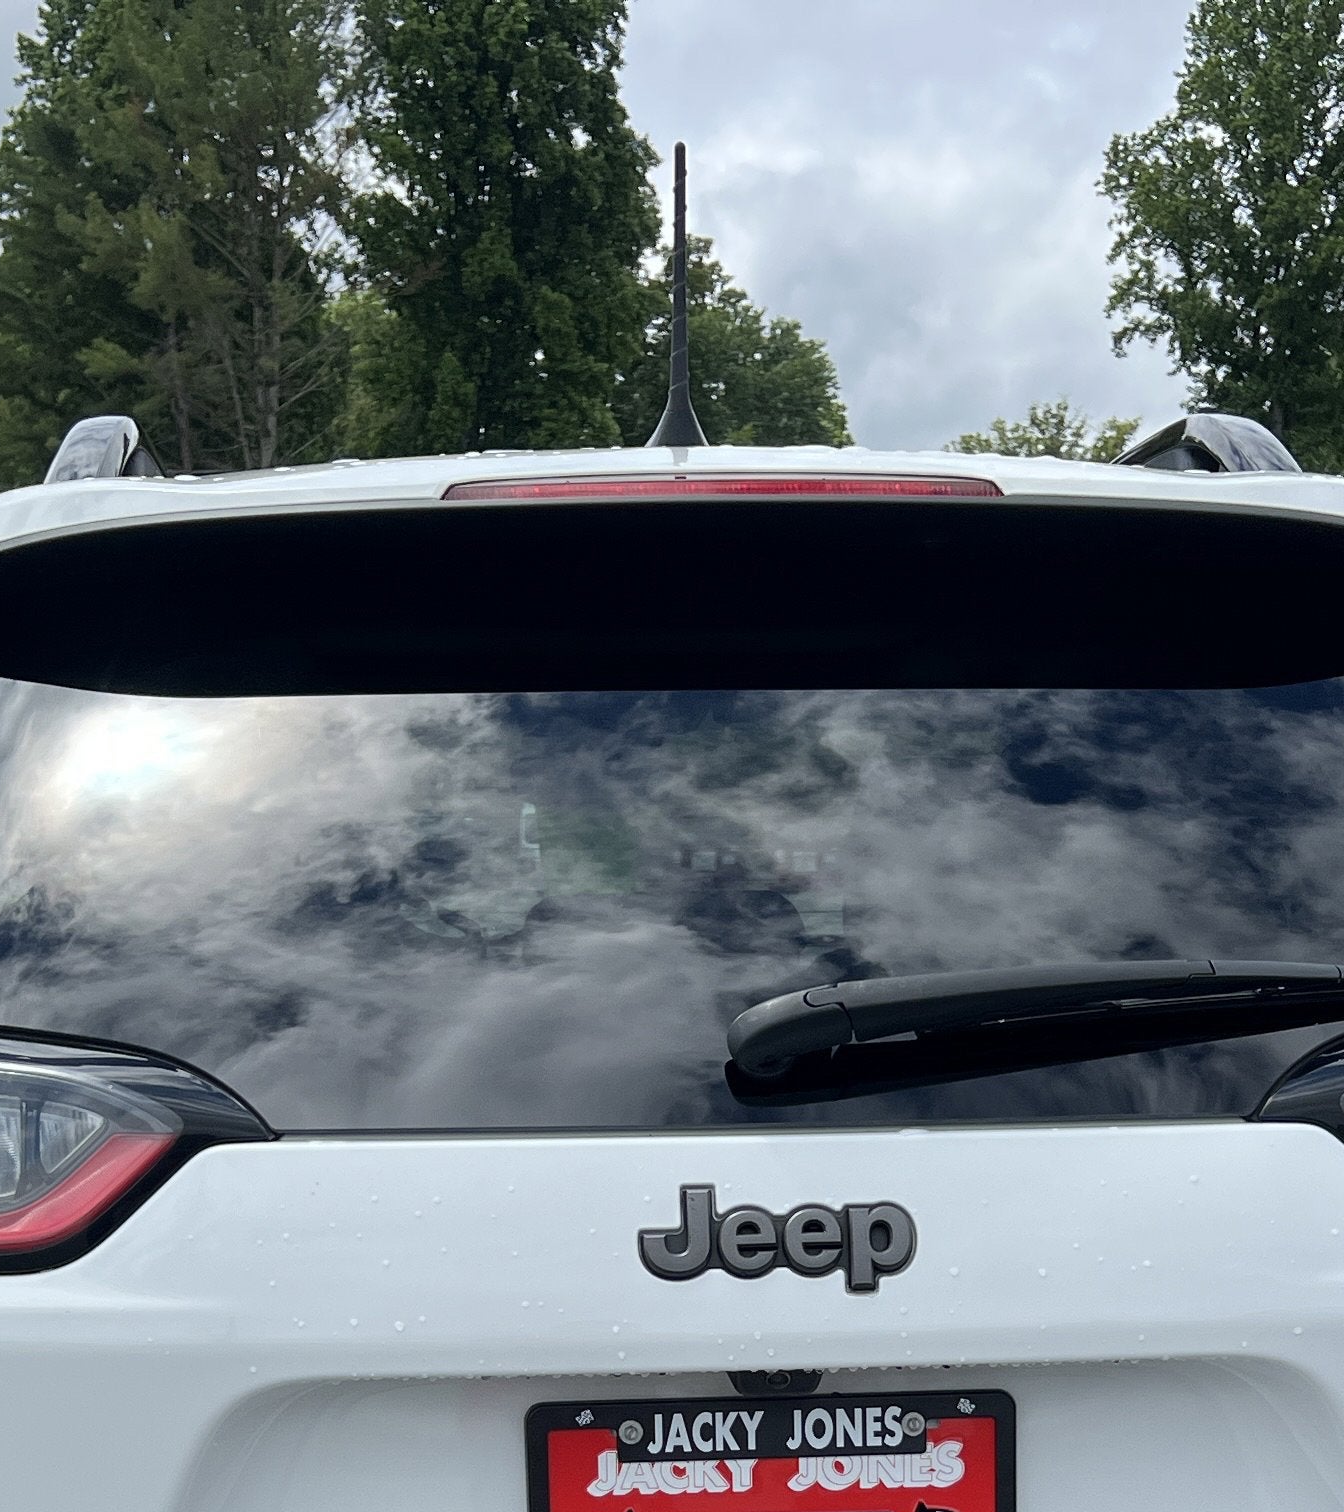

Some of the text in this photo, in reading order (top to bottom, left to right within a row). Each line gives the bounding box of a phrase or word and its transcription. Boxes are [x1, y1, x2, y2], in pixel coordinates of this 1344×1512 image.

[638, 1183, 917, 1296] Jeep
[647, 1405, 904, 1454] JACKY JONES
[587, 1439, 965, 1497] JACKY JONES
